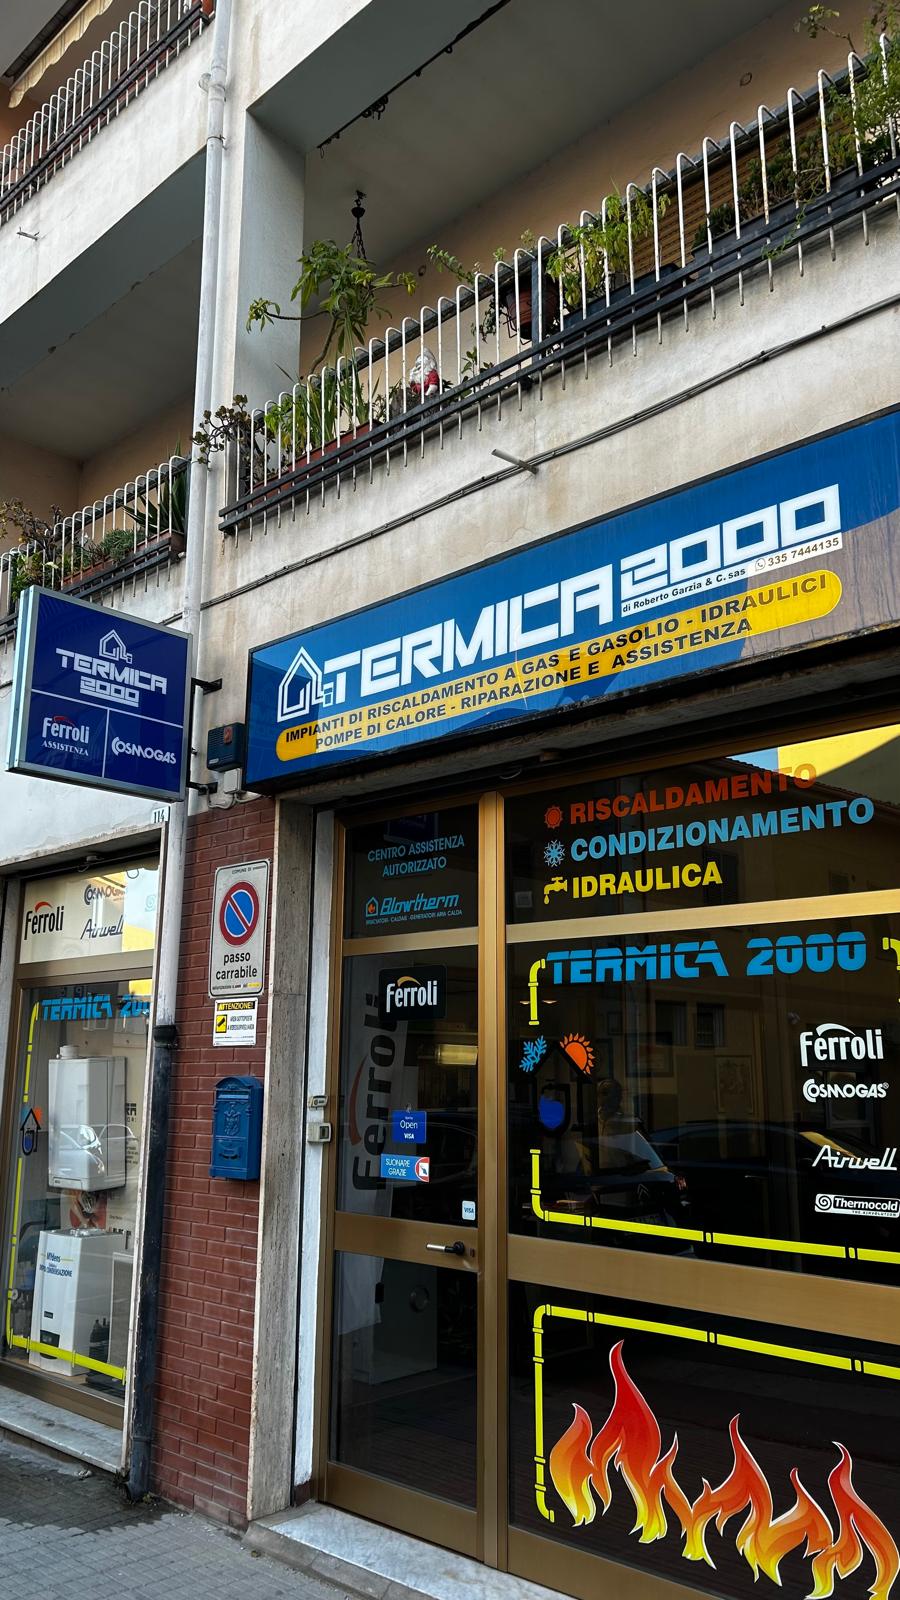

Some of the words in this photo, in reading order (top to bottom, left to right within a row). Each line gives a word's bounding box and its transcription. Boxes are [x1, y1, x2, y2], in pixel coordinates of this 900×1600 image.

[622, 603, 631, 613] di
[633, 590, 669, 609] Roberto
[671, 581, 702, 597] Garzia
[705, 578, 713, 587] &
[728, 568, 746, 579] sas
[767, 553, 788, 567] 335
[791, 537, 840, 560] 7444135
[324, 563, 613, 704] TERMICA
[621, 483, 841, 600] 2000
[55, 647, 168, 695] TERMICA
[285, 716, 345, 743] IMPIANTI
[349, 711, 363, 725] DI
[367, 672, 499, 720] RISCALDAMENTO
[504, 667, 516, 681] A
[521, 654, 560, 675] GAS
[569, 647, 580, 662] E
[587, 618, 680, 656] GASOLIO
[700, 574, 827, 623] IDRAULICI
[79, 675, 140, 704] 2000
[315, 727, 363, 750] POMPE
[367, 722, 381, 736] DI
[385, 704, 446, 731] CALORE
[461, 666, 581, 710] RIPARAZIONE
[588, 661, 599, 675] E
[611, 618, 753, 669] ASSISTENZA
[42, 717, 90, 744] Ferroli
[41, 740, 89, 757] ASSISTENZA
[111, 736, 177, 765] COSMOGAS
[569, 763, 818, 825] RISCALDAMENTO
[153, 809, 165, 823] 114
[570, 797, 875, 863] CONDIZIONAMENTO
[367, 845, 406, 862] CENTRO
[408, 834, 465, 856] ASSISTENZA
[382, 856, 447, 878] AUTORIZZATO
[572, 861, 723, 899] IDRAULICA
[380, 893, 460, 916] Blowtherm
[24, 905, 65, 941] Ferroli
[223, 951, 251, 966] passo
[545, 940, 729, 985] TERMICA
[746, 931, 867, 976] 2000
[215, 966, 258, 981] carrabile
[41, 994, 113, 1021] TERMICA
[217, 1002, 254, 1011] ATTENZIONE!
[386, 980, 438, 1013] Ferroli
[800, 1028, 884, 1067] Ferroli
[399, 1119, 419, 1130] Open
[403, 1132, 415, 1140] VISA
[385, 1158, 411, 1168] SUONARE
[812, 1144, 898, 1171] Airwell
[388, 1168, 407, 1177] GRAZIE
[463, 1206, 474, 1214] VISA
[834, 1197, 899, 1212] Thermocold
